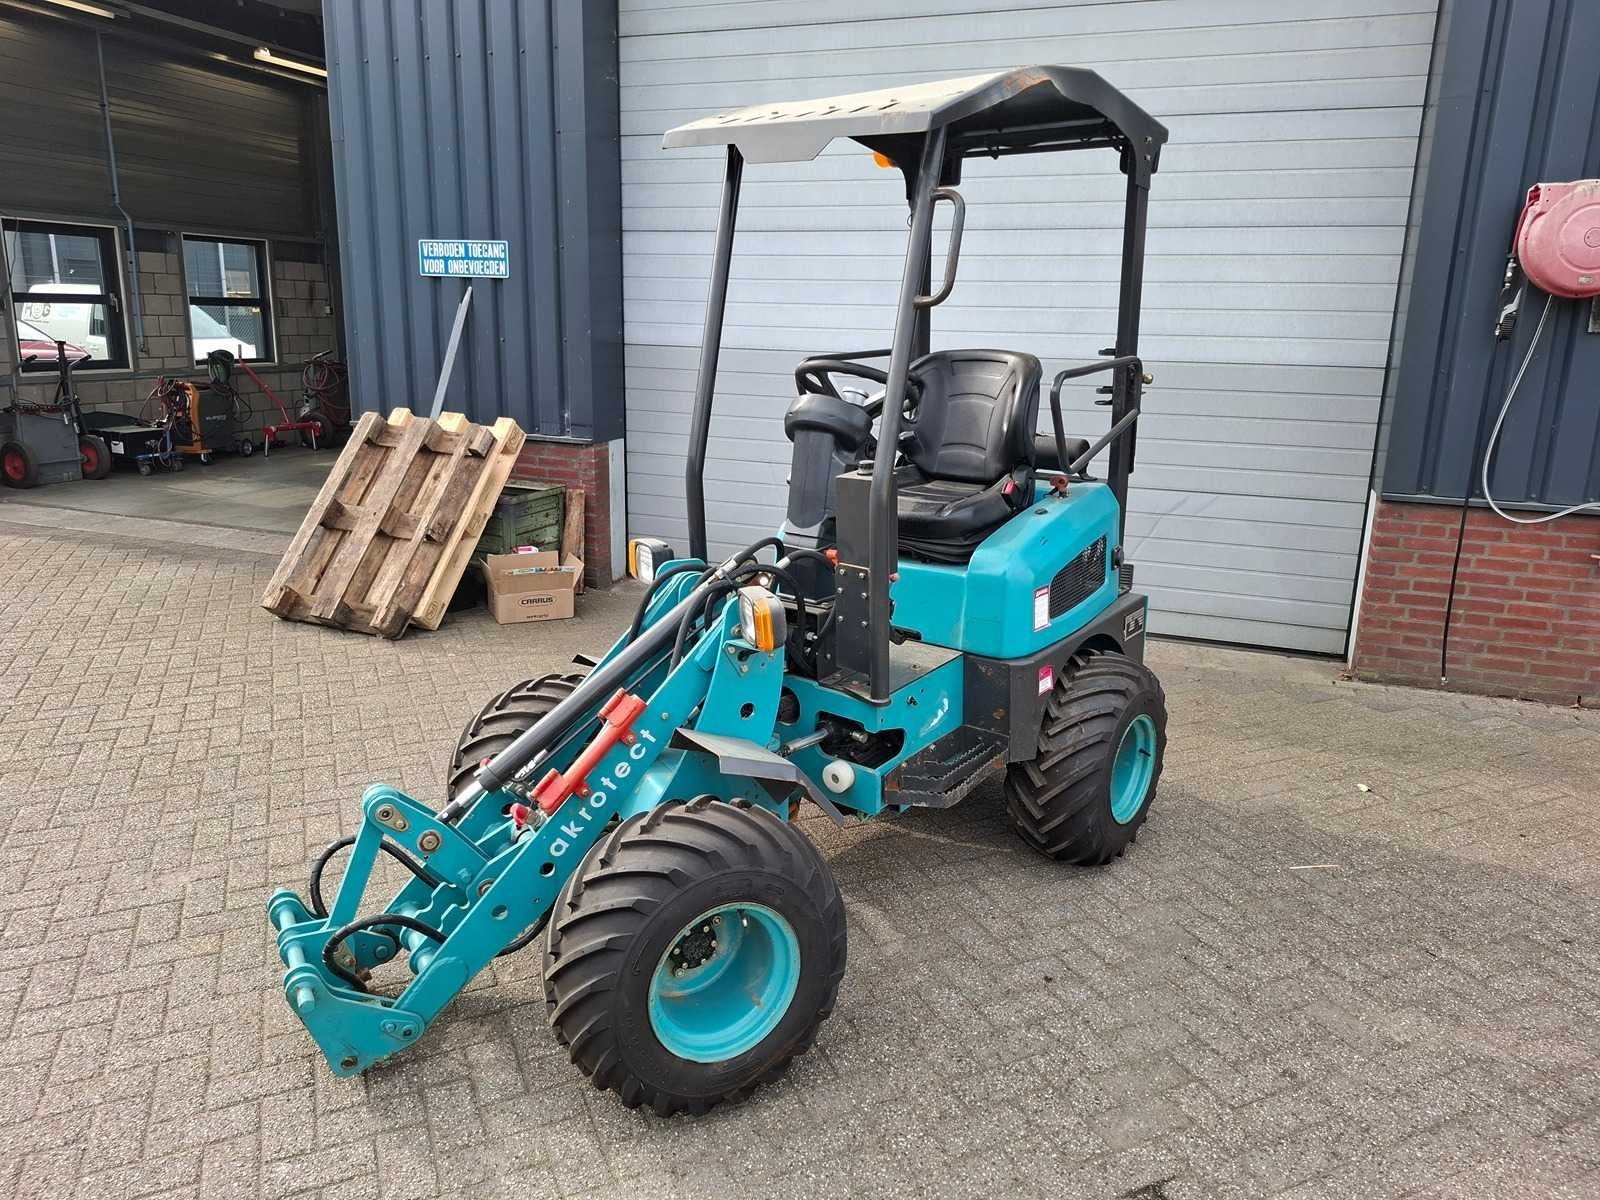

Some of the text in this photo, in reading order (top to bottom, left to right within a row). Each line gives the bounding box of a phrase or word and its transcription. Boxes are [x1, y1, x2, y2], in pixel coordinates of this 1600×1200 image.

[422, 242, 505, 258] VERBODEN TOEGANG
[423, 259, 506, 275] VOOR ONBEVOEGDEN
[550, 729, 656, 857] akrotect
